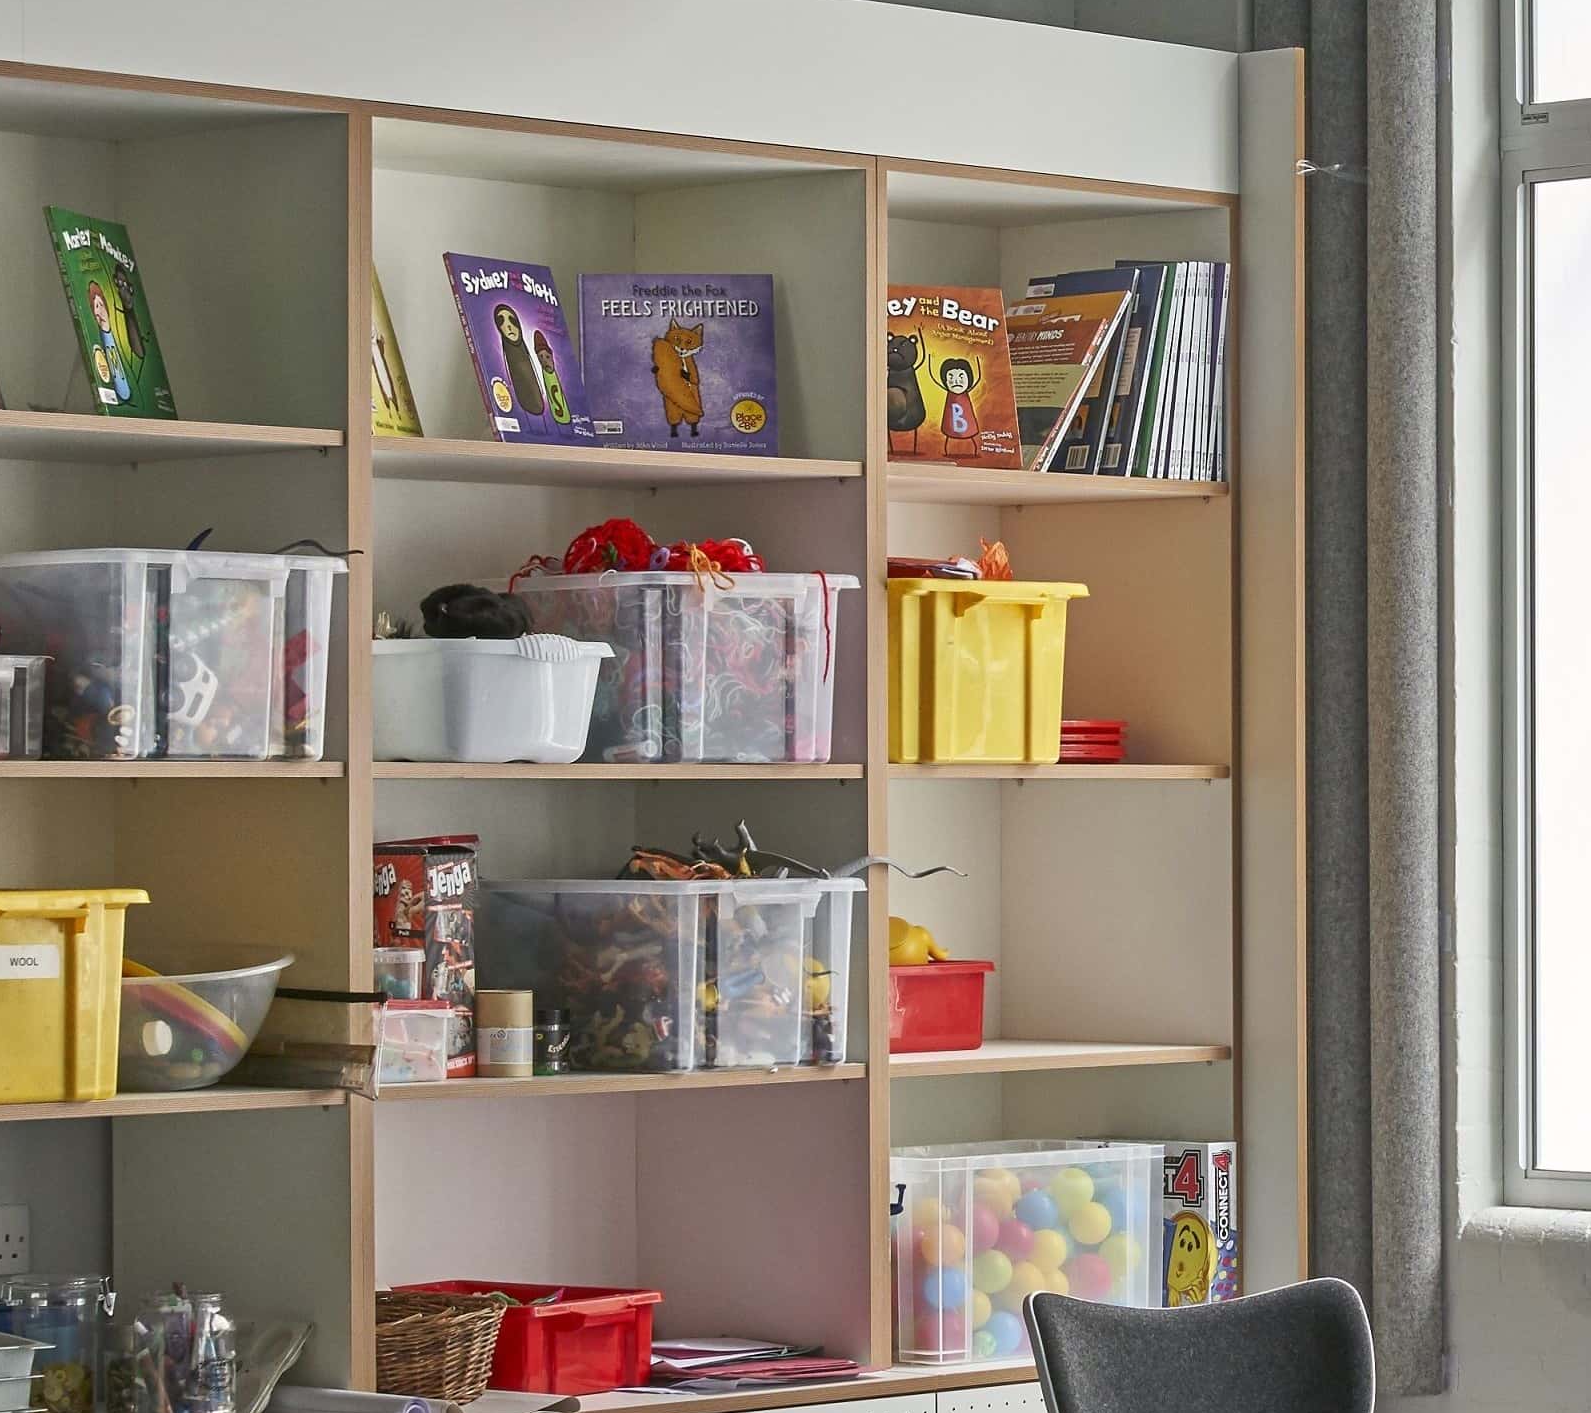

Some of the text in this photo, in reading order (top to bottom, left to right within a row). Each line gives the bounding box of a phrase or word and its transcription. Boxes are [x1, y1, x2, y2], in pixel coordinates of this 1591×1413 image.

[460, 268, 509, 295] Sydney
[521, 273, 559, 306] Sloth
[632, 284, 728, 297] Freddie the Fox
[601, 299, 760, 317] FEELS FRIGHTENED
[918, 296, 940, 306] and
[920, 306, 940, 317] the
[942, 298, 1000, 332] Bear
[951, 403, 969, 434] B
[427, 861, 472, 897] Jenga
[9, 957, 39, 967] WOOL
